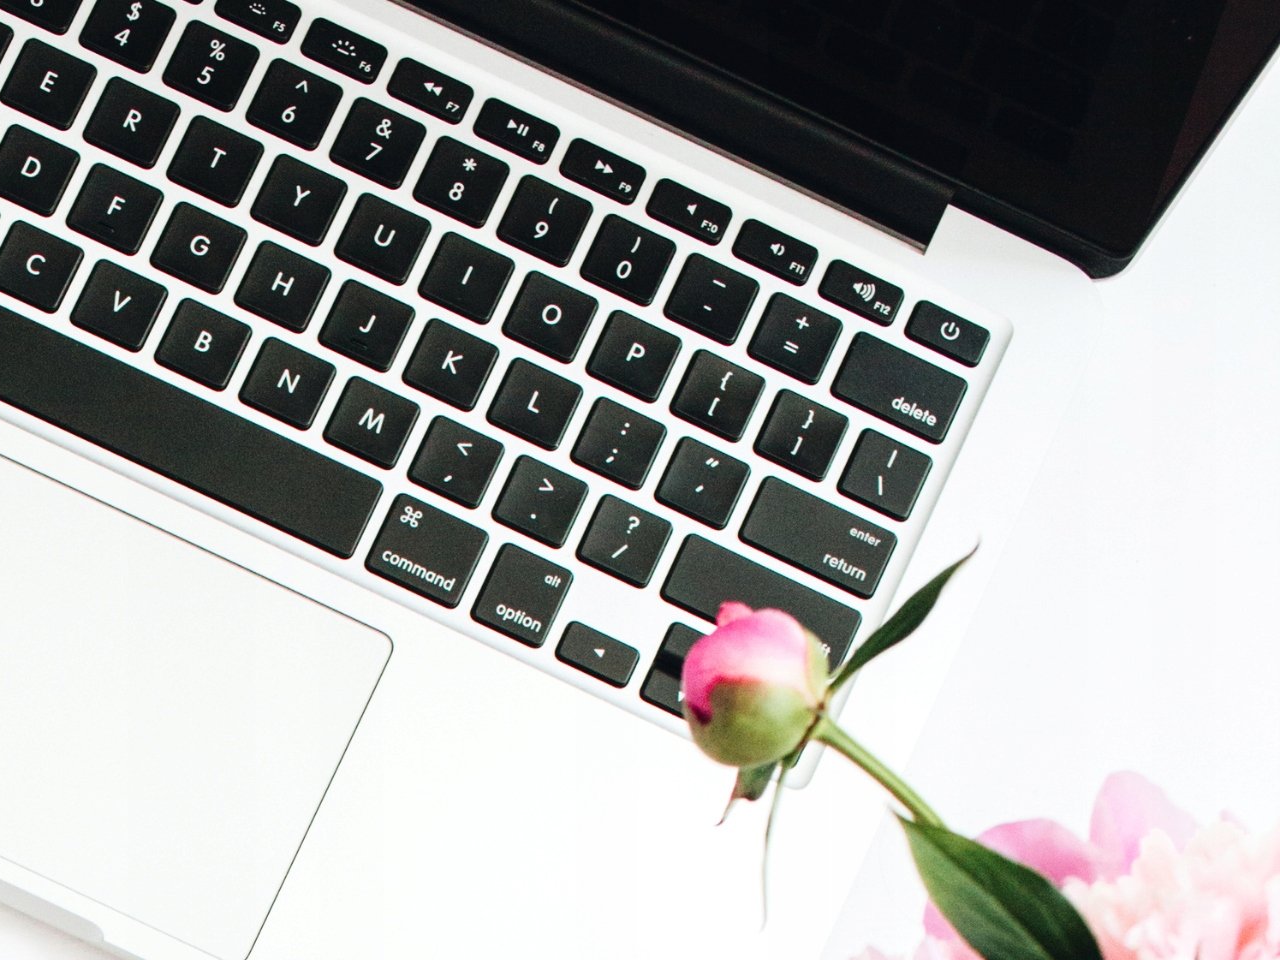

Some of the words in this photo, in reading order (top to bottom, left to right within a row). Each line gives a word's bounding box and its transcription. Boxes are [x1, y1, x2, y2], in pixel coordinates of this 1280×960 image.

[126, 1, 143, 21] $
[272, 20, 286, 32] F5
[114, 28, 131, 47] 4
[209, 39, 226, 61] %
[196, 66, 215, 85] 5
[359, 60, 372, 73] F6
[39, 70, 59, 93] E
[281, 105, 297, 123] 6
[445, 101, 460, 113] F7
[122, 109, 142, 132] R
[375, 118, 392, 139] &
[365, 142, 383, 161] 7
[532, 140, 545, 152] F8
[20, 156, 41, 178] D
[210, 147, 227, 169] T
[293, 185, 311, 207] Y
[448, 182, 465, 201] 8
[618, 181, 632, 193] F9
[107, 195, 126, 215] F
[374, 224, 396, 247] U
[533, 221, 549, 239] 9
[190, 235, 211, 256] G
[26, 254, 46, 276] C
[461, 265, 474, 285] I
[616, 260, 632, 279] 0
[789, 261, 805, 275] F11
[271, 271, 295, 296] H
[113, 290, 132, 313] V
[873, 301, 891, 316] F12
[359, 314, 376, 333] J
[541, 304, 562, 325] O
[194, 330, 213, 352] B
[441, 350, 463, 375] K
[626, 342, 646, 362] P
[277, 368, 301, 394] N
[527, 390, 539, 414] L
[890, 395, 938, 428] delete
[358, 407, 385, 434] M
[626, 515, 640, 534] ?
[848, 525, 882, 547] enter
[380, 546, 457, 594] command
[822, 550, 868, 583] return
[544, 575, 562, 588] alt
[494, 600, 543, 635] option
